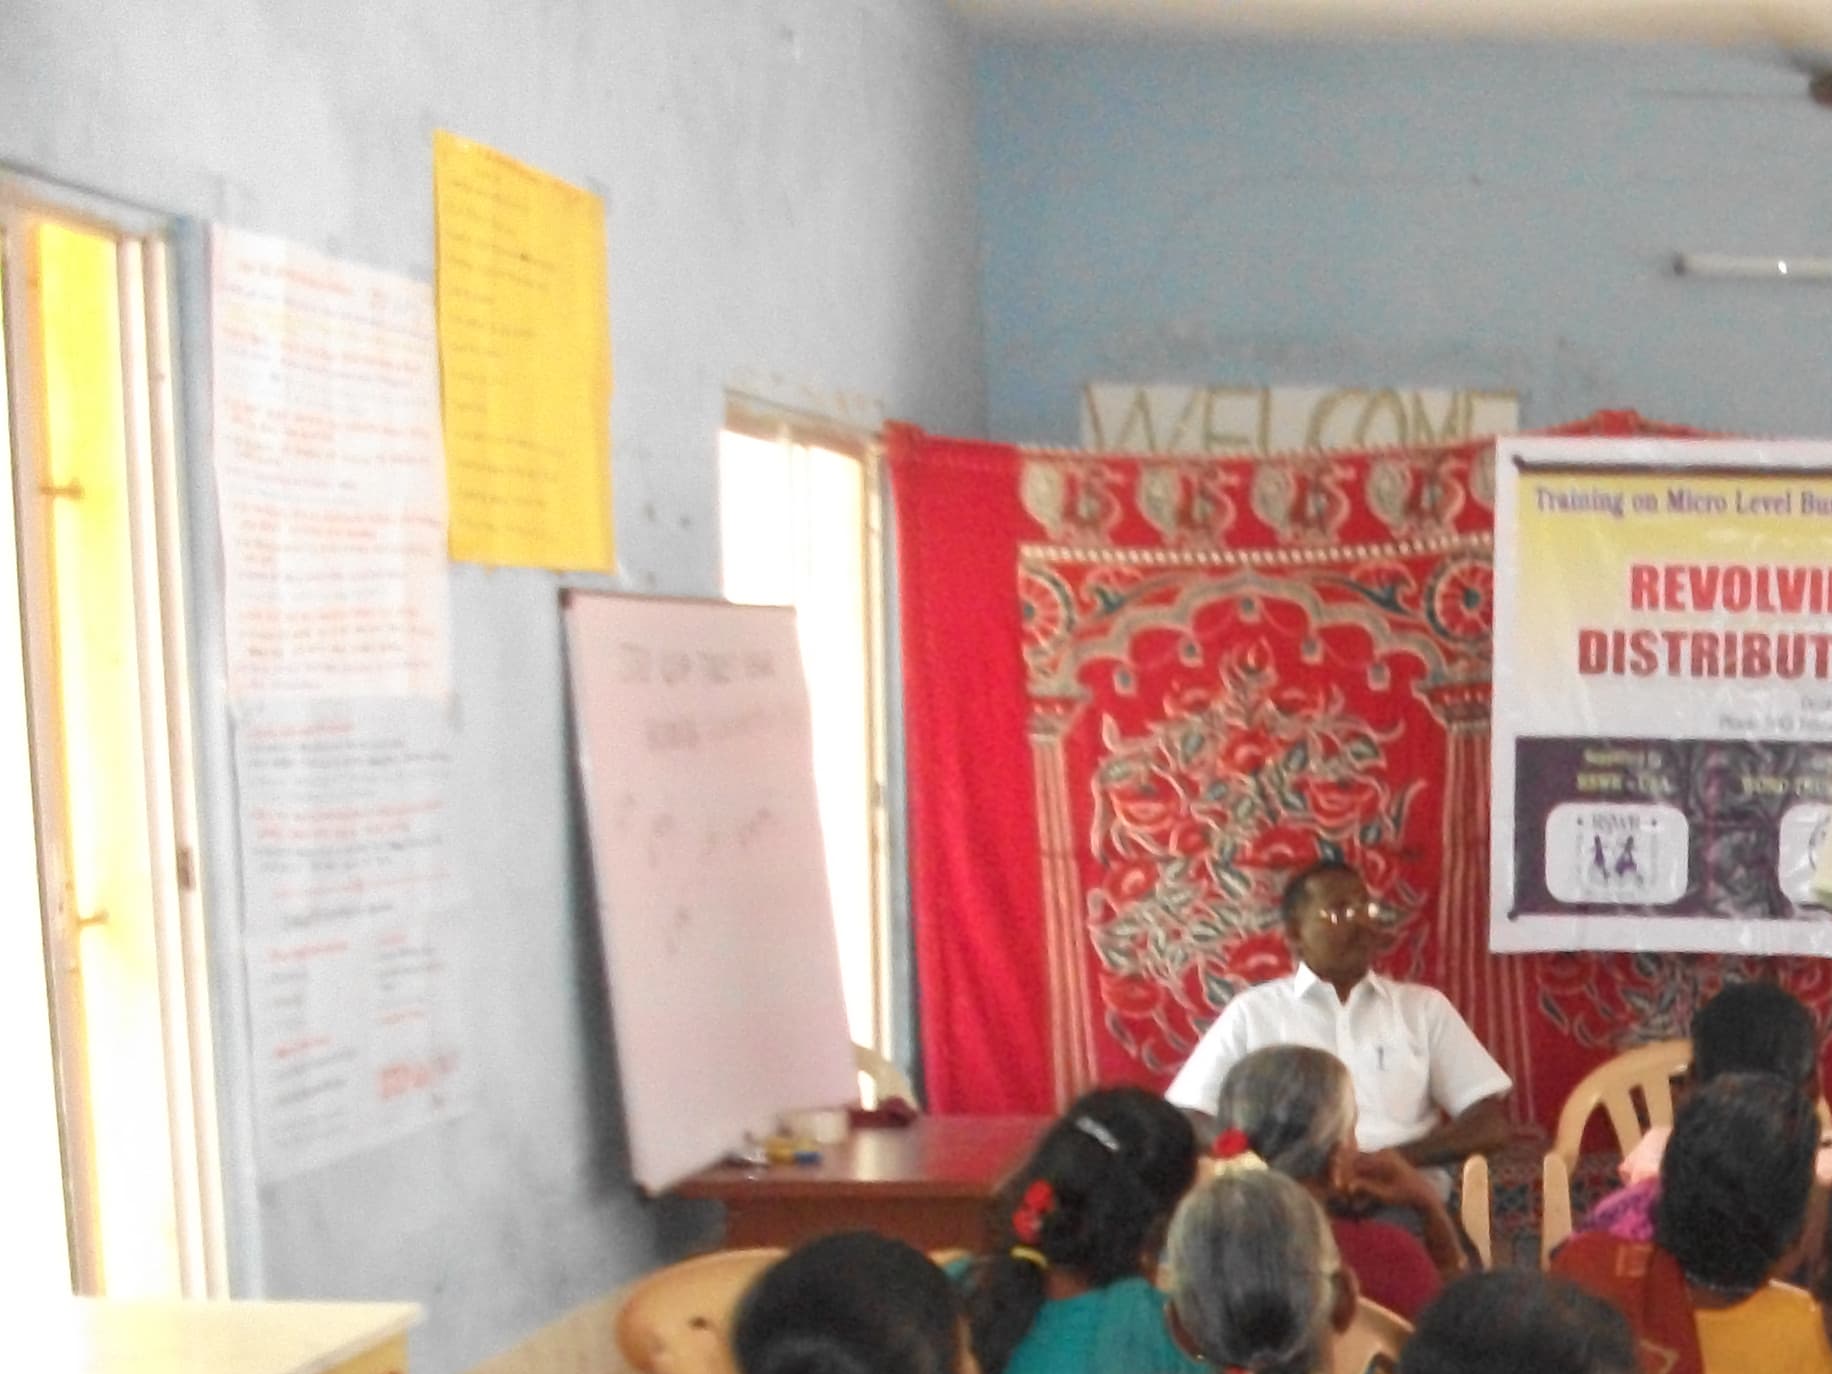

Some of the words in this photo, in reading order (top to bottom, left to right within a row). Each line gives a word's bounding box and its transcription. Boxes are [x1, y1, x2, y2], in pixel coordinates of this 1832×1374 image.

[1537, 486, 1624, 518] Training
[1631, 494, 1659, 513] on
[1666, 488, 1727, 514] Micro
[1736, 488, 1791, 514] Level
